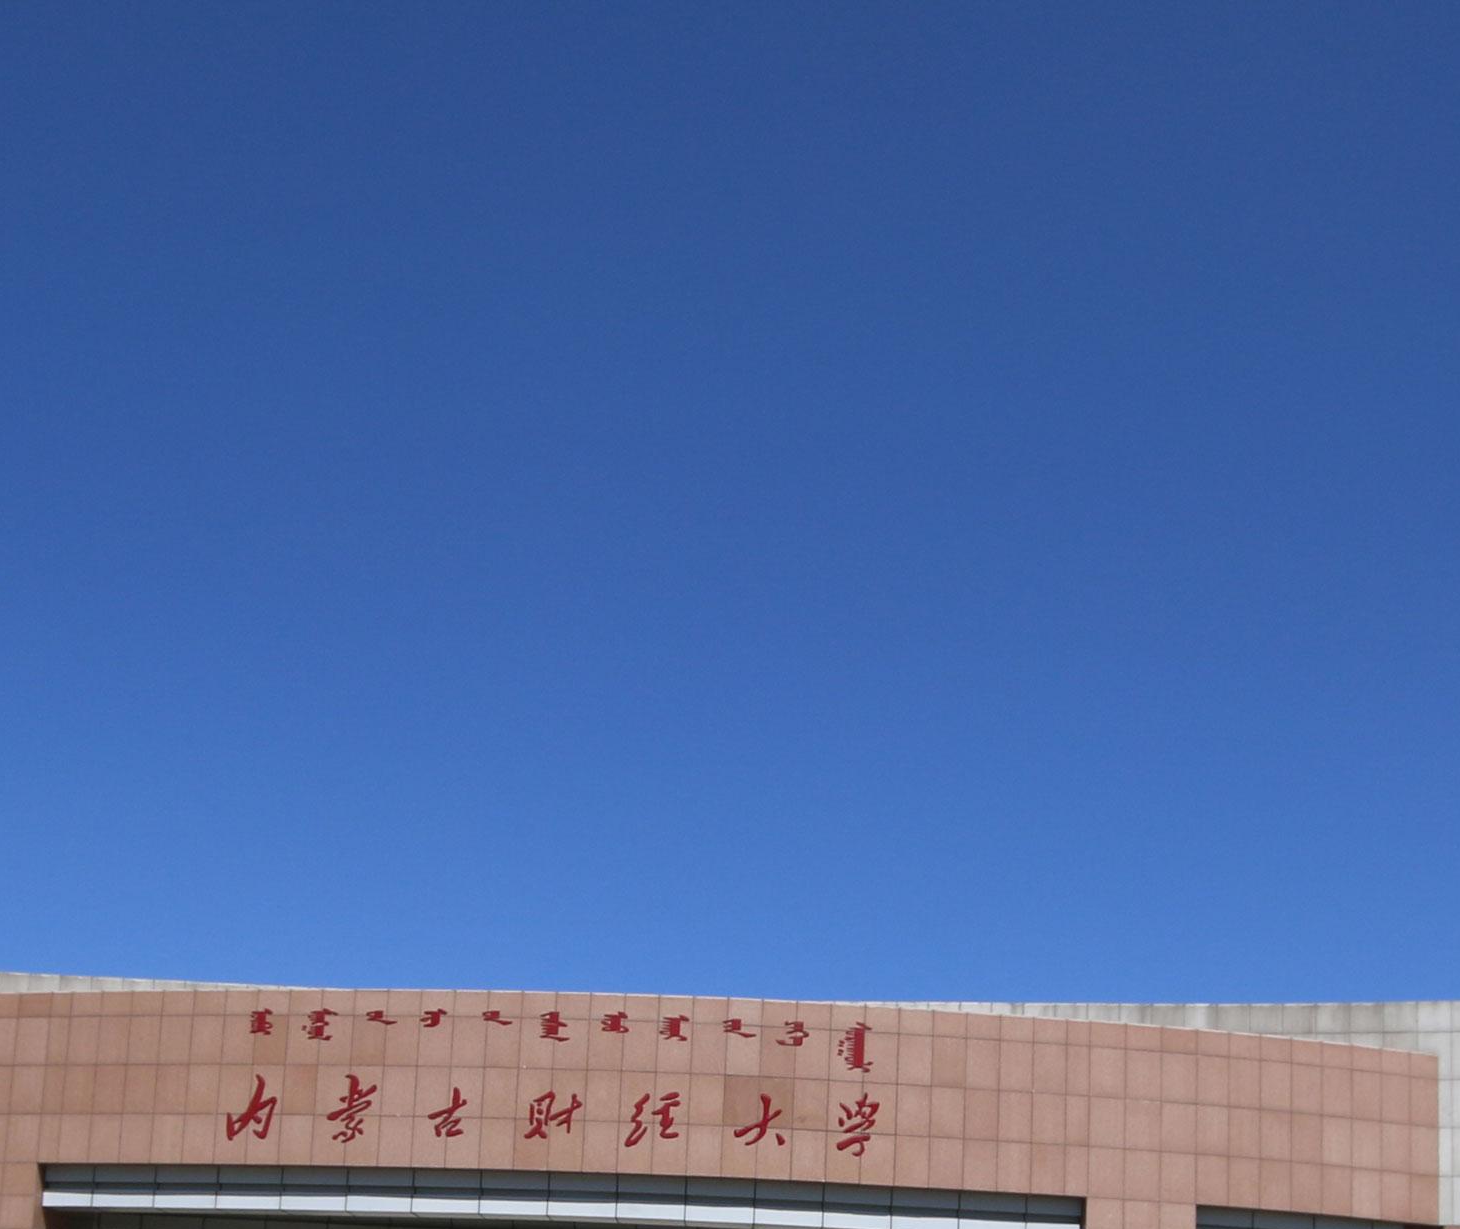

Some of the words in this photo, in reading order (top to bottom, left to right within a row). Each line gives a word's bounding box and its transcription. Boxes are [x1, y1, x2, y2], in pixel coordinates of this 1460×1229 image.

[226, 1074, 880, 1157] 内蒙古财经大学
